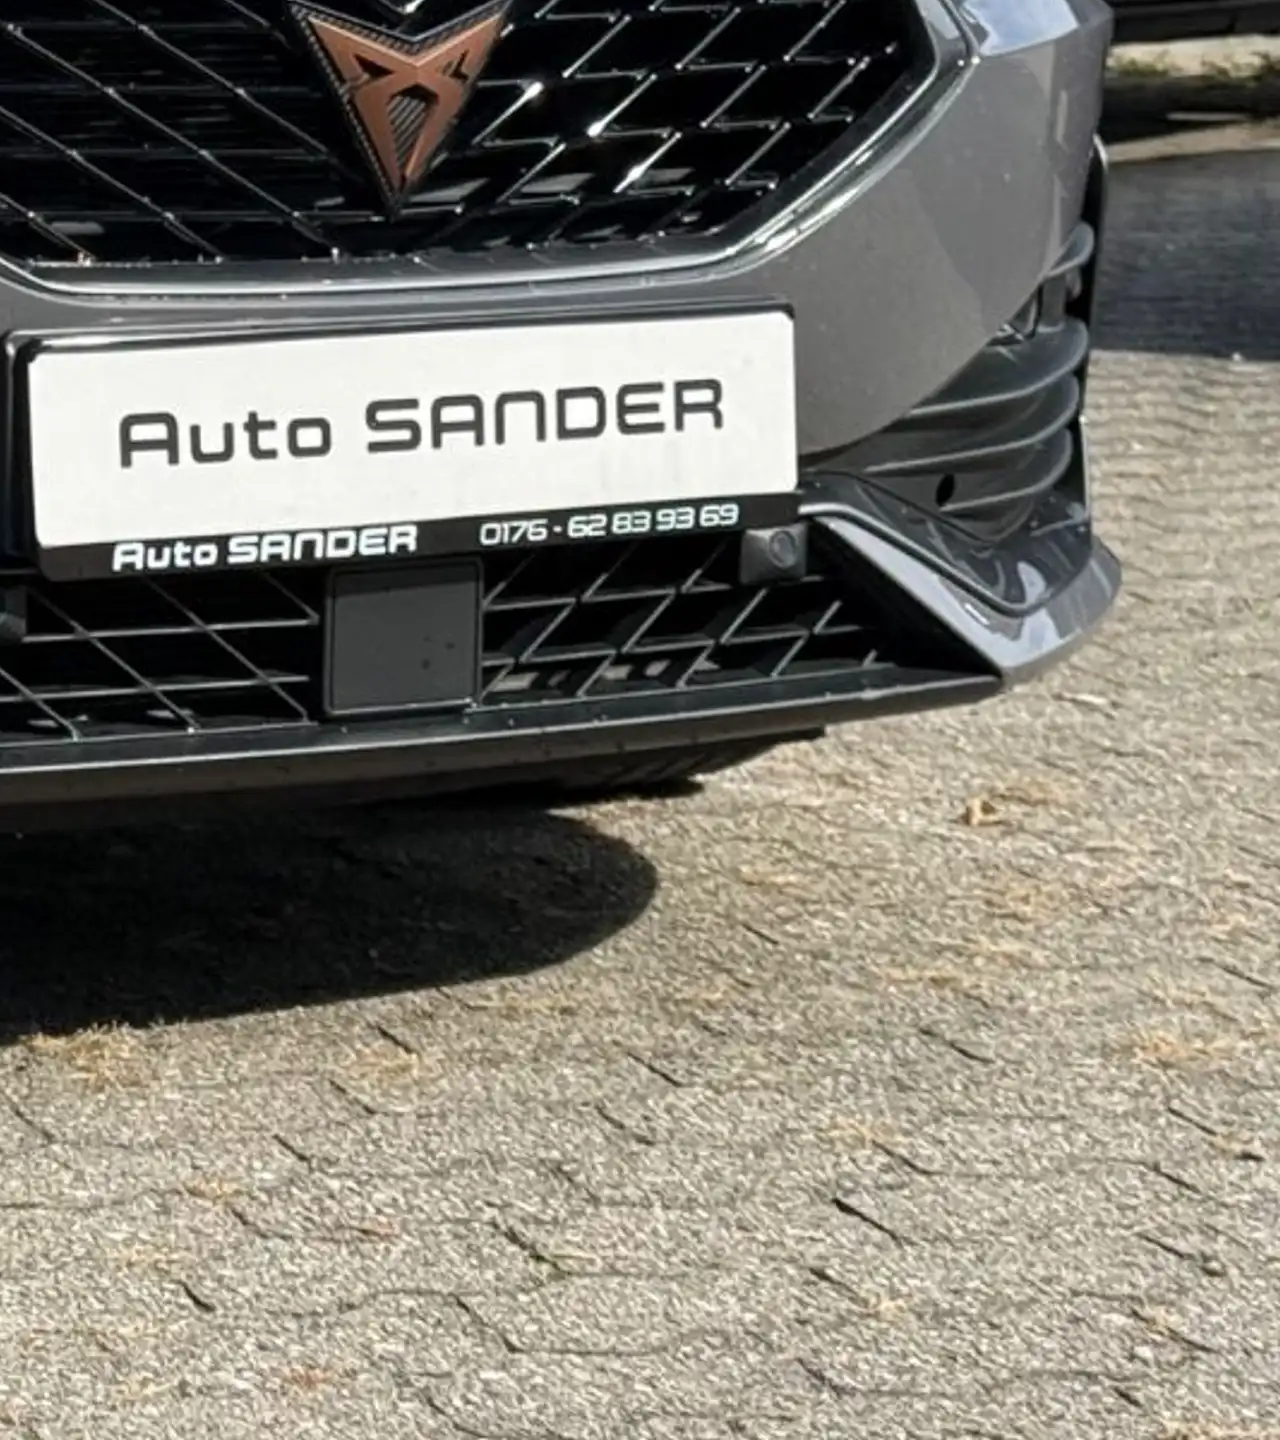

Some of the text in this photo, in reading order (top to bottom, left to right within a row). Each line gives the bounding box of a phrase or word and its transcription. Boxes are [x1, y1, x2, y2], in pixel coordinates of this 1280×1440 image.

[119, 378, 724, 468] Auto SANDER
[112, 541, 219, 572] Auto
[226, 523, 418, 565] SANDER
[479, 518, 549, 547] 0176
[567, 513, 607, 539] 62
[612, 509, 652, 535] 83
[655, 506, 696, 532] 93
[699, 502, 740, 528] 69
